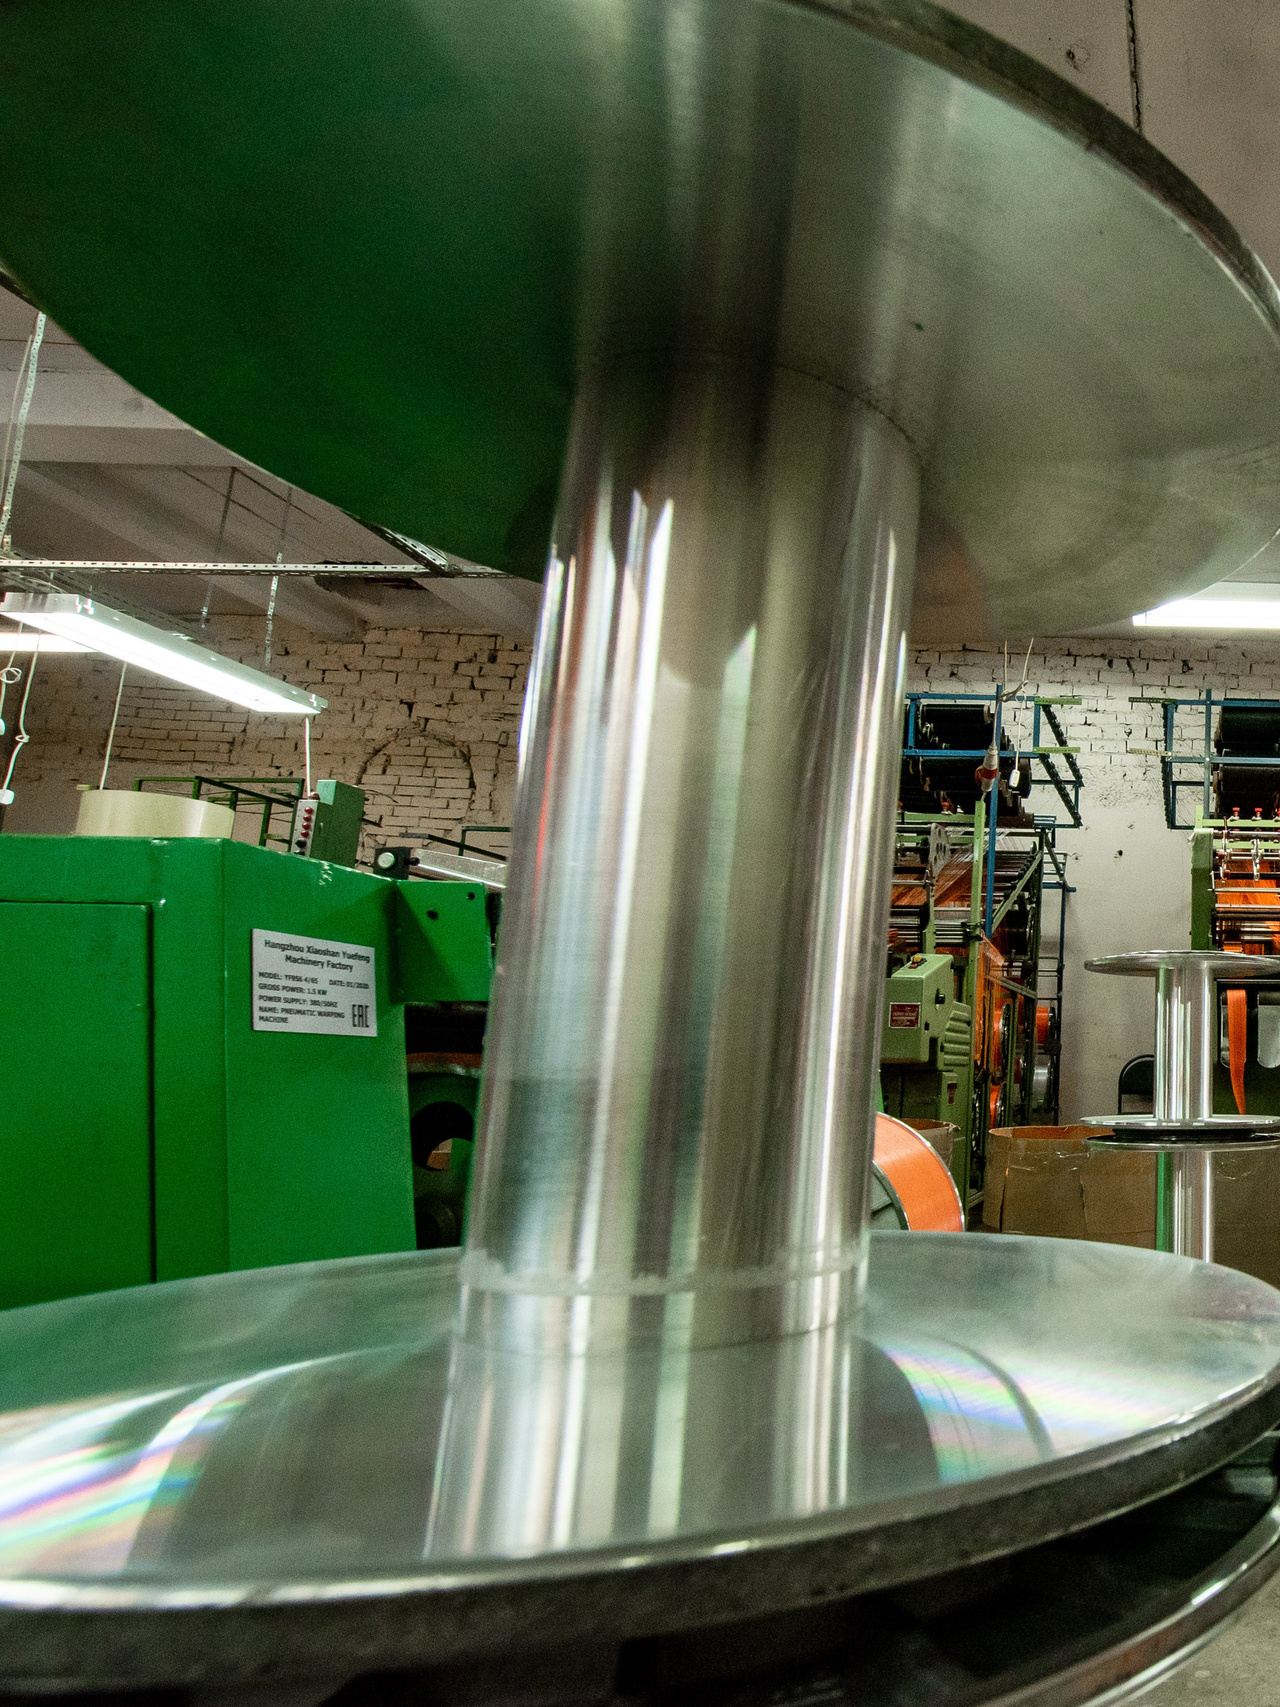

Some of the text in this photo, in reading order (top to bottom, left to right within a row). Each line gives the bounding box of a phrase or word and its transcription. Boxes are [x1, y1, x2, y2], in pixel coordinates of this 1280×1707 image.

[264, 939, 371, 964] Hangzhou Xiaoshan Yuefeng
[285, 954, 354, 973] Machinery Factory
[258, 971, 282, 980] MODEL:
[329, 979, 345, 987] DATE:
[258, 983, 280, 991] GROSS
[281, 985, 306, 994] POWER:
[258, 994, 282, 1002] POWER
[283, 997, 308, 1005] SUPPLY:
[280, 1007, 316, 1016] PNEUMATIC
[317, 1010, 345, 1019] WARPING
[258, 1015, 289, 1024] MACHINE
